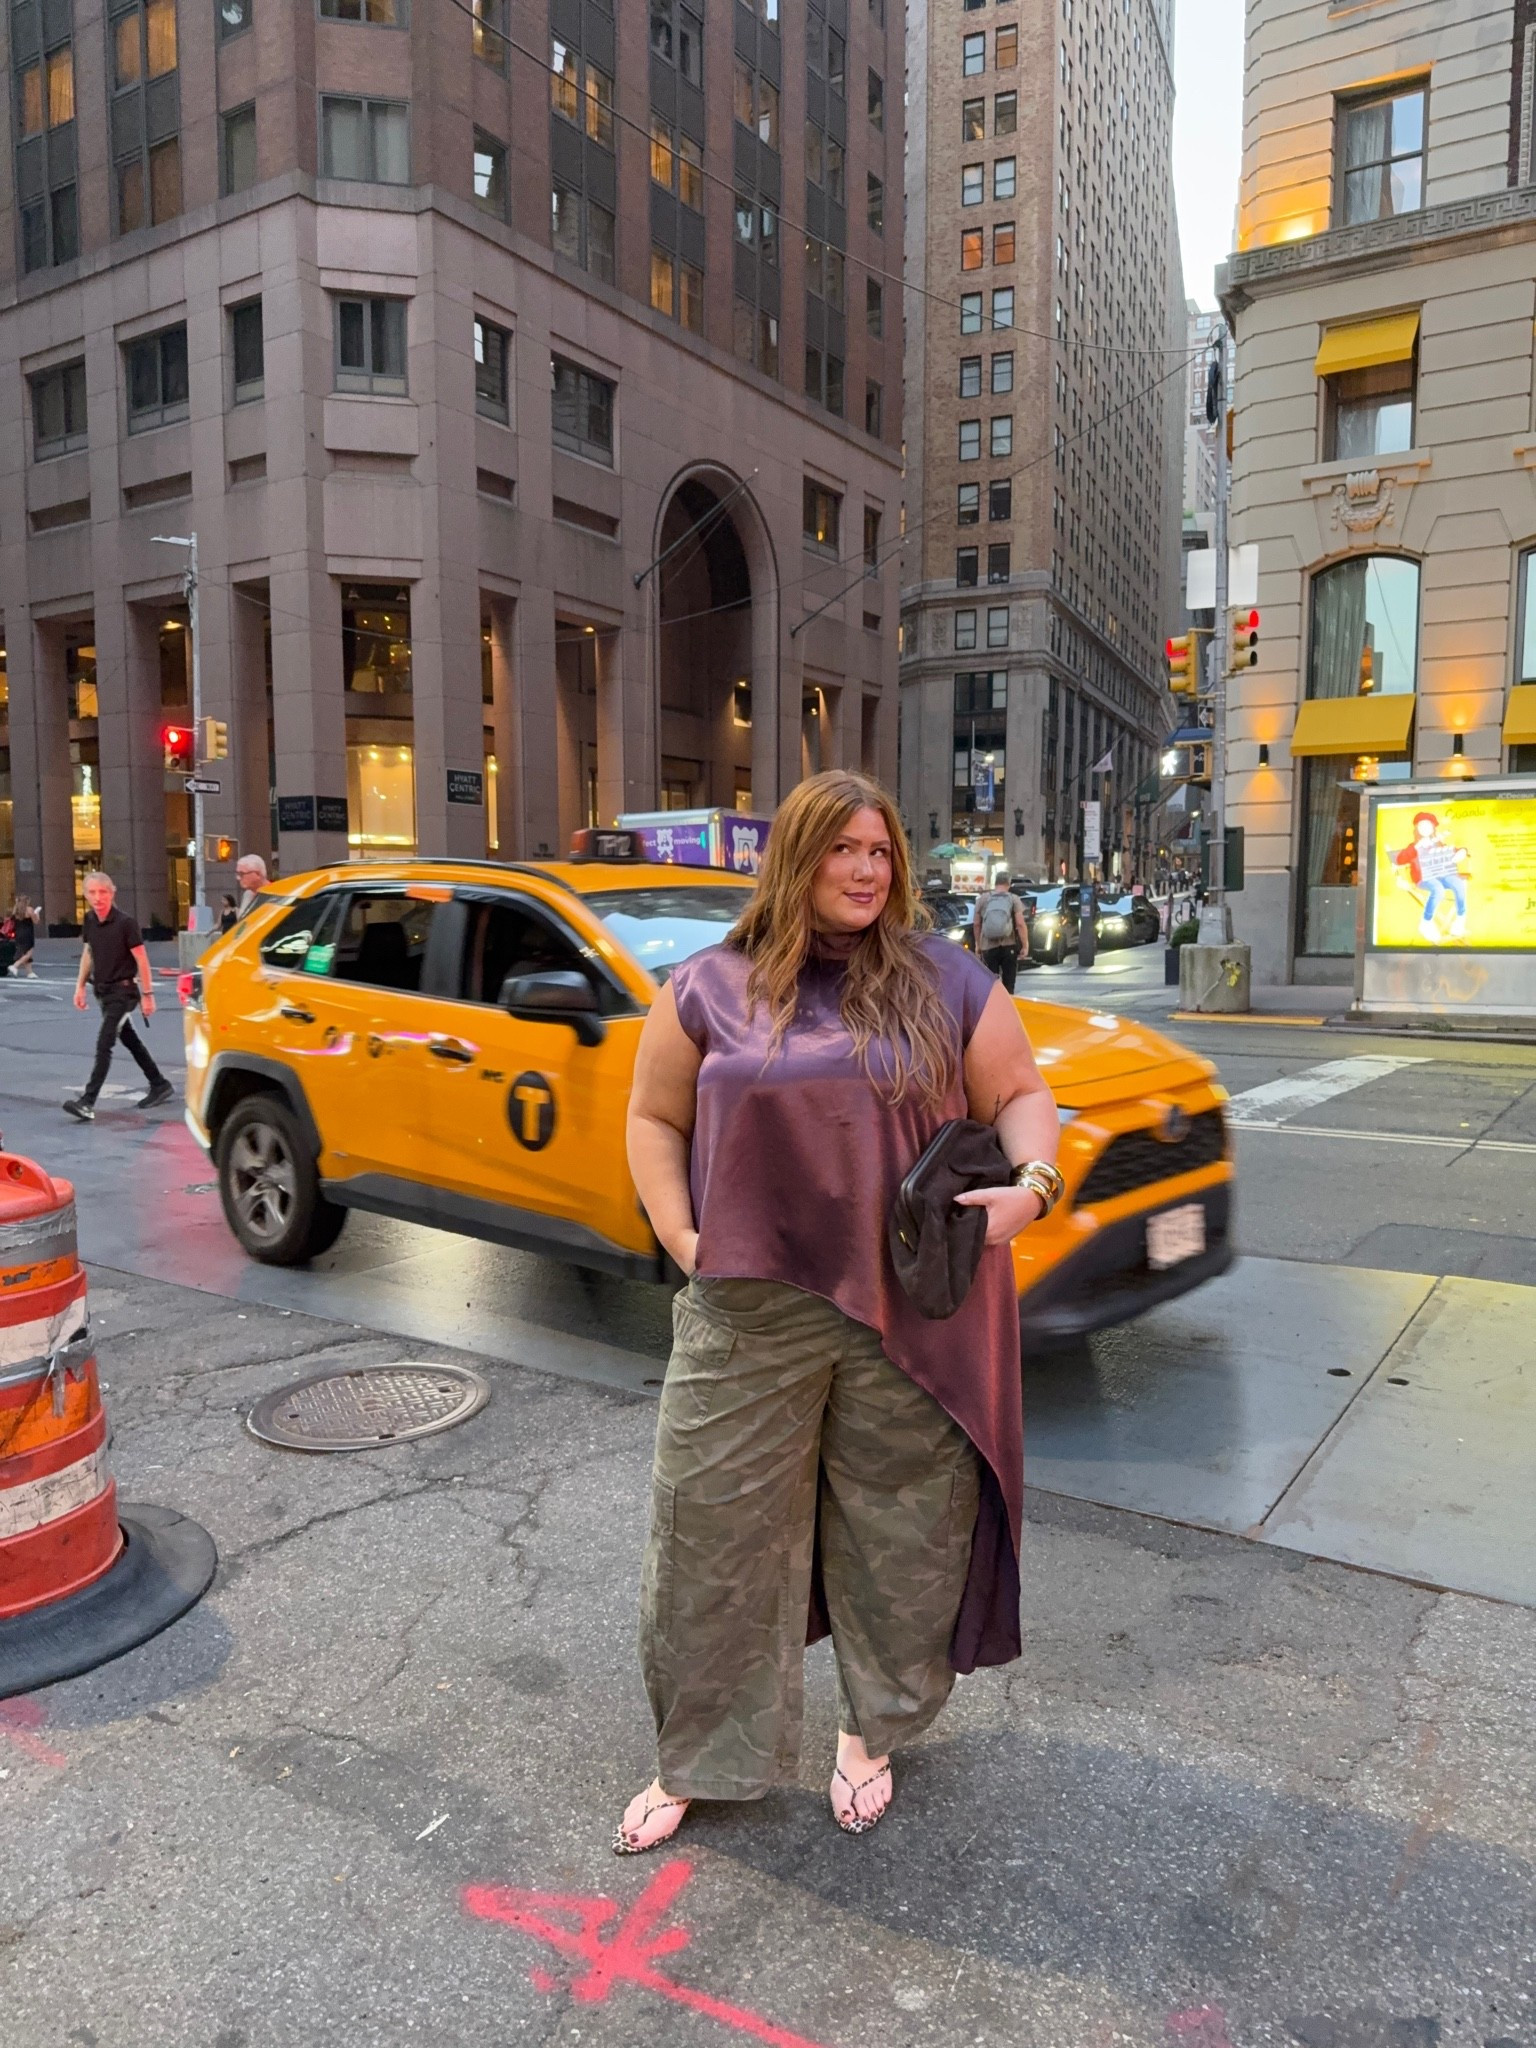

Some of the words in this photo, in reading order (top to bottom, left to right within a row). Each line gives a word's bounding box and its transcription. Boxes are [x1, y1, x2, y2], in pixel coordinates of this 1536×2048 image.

[454, 774, 477, 784] HYATT
[449, 782, 480, 794] CENTRIC
[674, 836, 700, 846] moving
[514, 1086, 550, 1141] T
